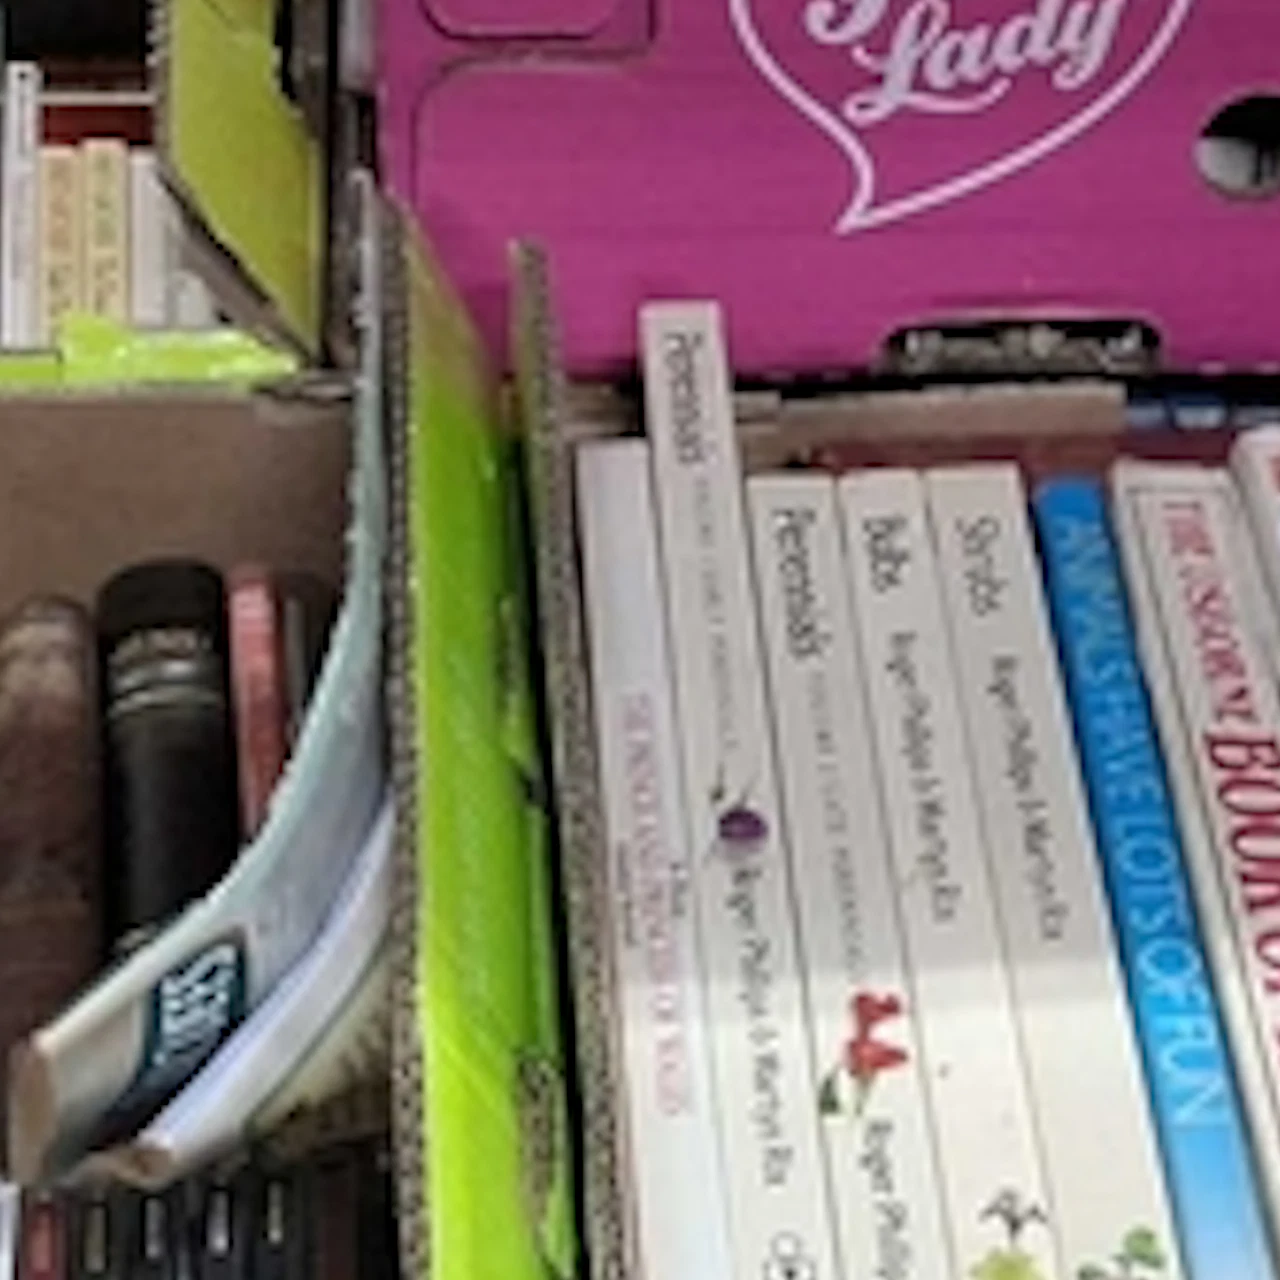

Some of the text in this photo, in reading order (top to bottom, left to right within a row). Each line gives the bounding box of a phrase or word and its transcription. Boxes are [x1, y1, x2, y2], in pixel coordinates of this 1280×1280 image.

[956, 515, 1010, 619] Shrubs
[1114, 818, 1190, 934] LOTS
[1136, 934, 1207, 1014] OF
[1154, 1018, 1231, 1124] FUN
